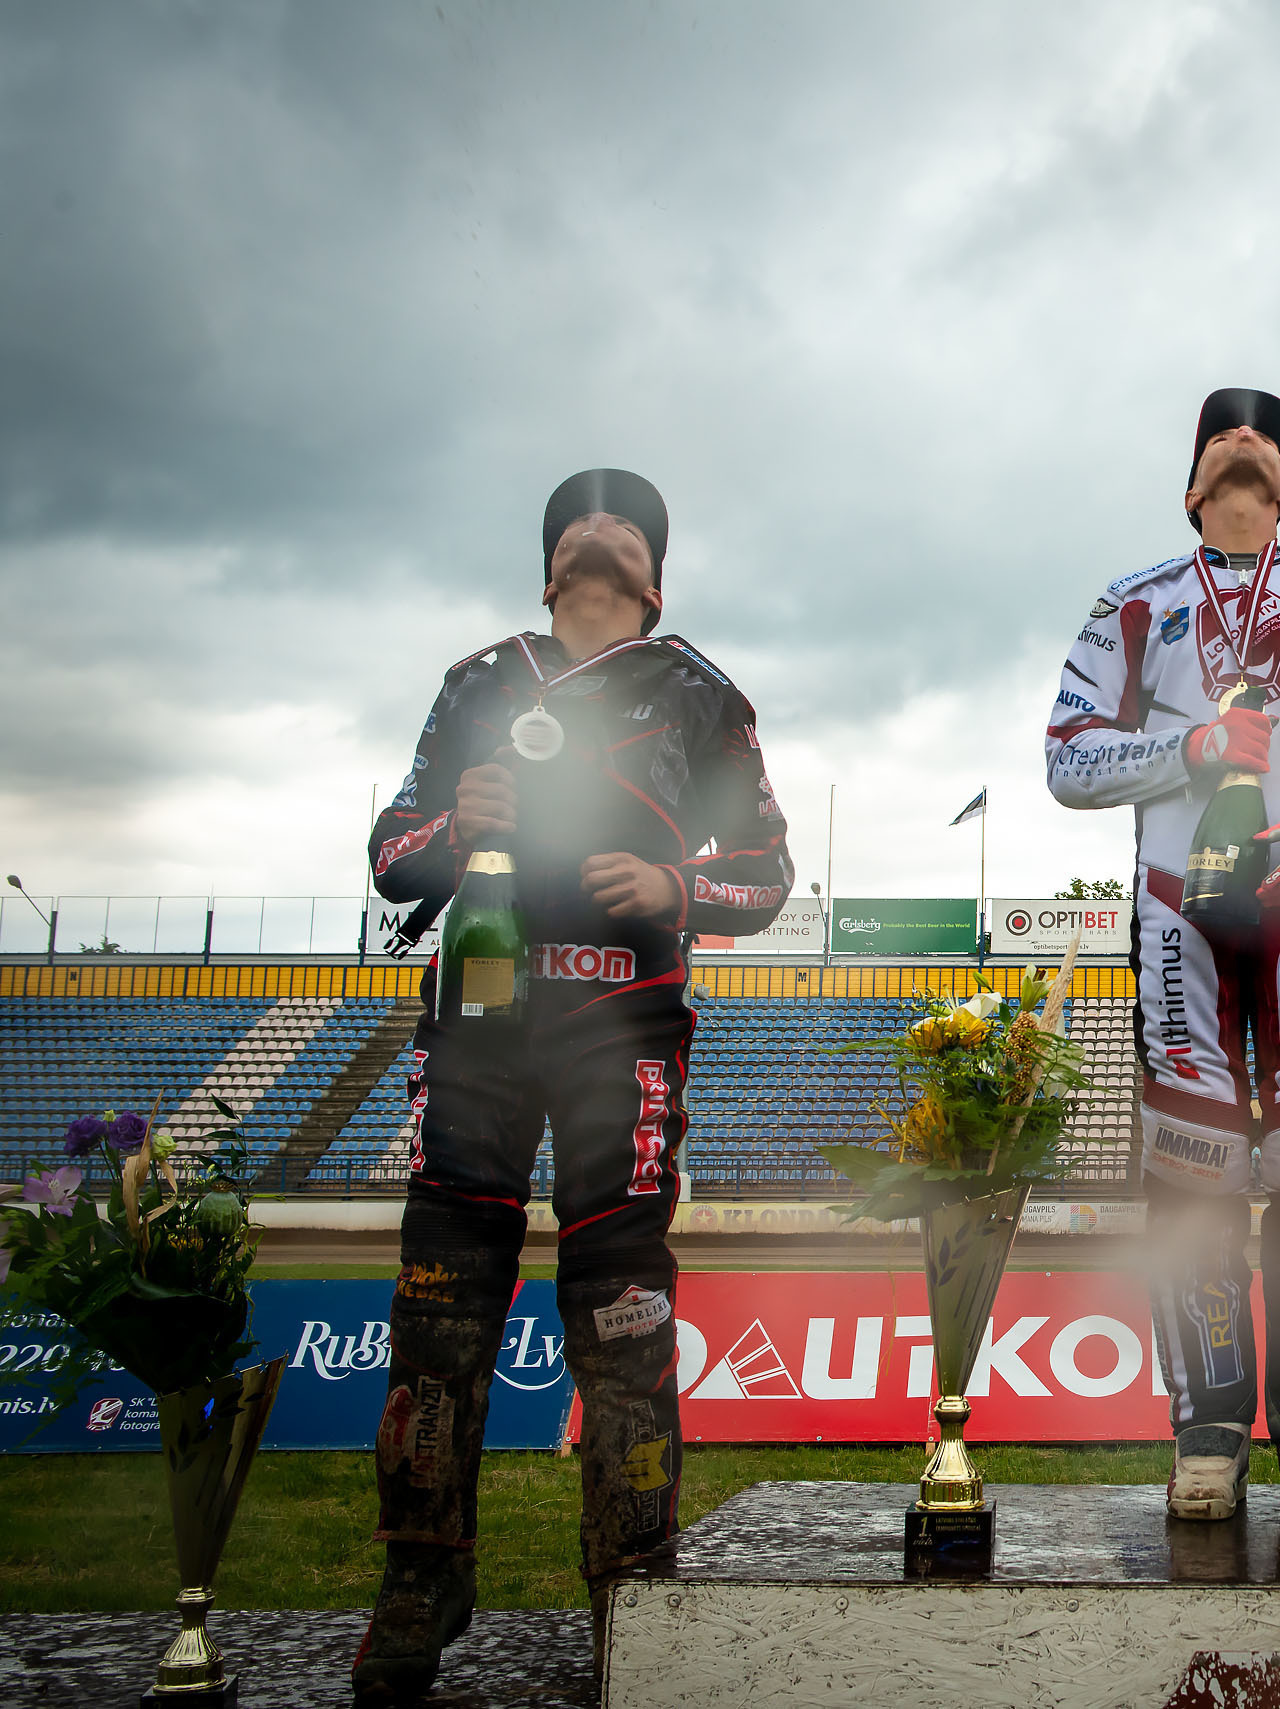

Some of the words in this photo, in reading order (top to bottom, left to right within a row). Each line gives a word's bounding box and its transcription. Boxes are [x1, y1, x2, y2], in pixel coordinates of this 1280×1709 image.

[1056, 689, 1097, 713] AUTO
[801, 914, 820, 922] OF
[1038, 911, 1118, 929] OPTIBET
[760, 927, 810, 936] RITING
[838, 917, 881, 934] Carlsberg
[129, 1397, 145, 1407] SK
